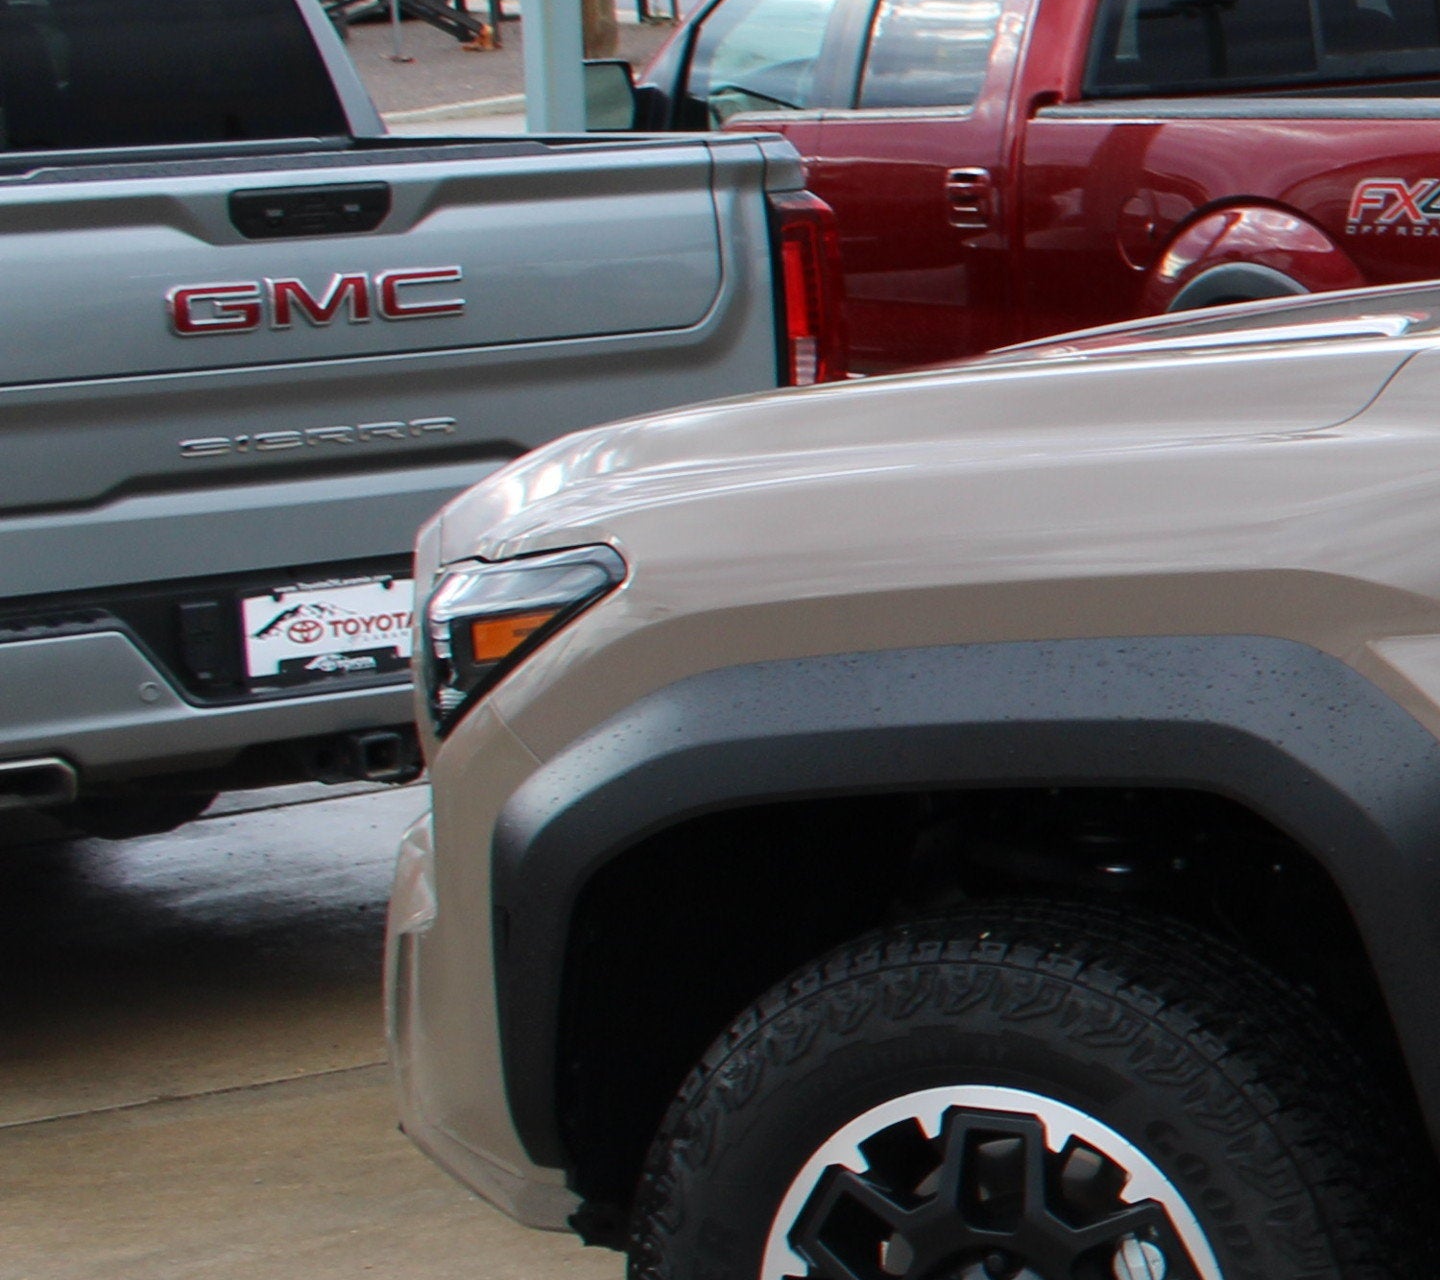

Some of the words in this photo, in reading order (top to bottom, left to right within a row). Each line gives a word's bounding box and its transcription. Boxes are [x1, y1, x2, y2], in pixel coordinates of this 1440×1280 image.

[1345, 224, 1388, 235] OFF
[165, 265, 466, 337] GMC
[178, 417, 457, 457] SIERRA
